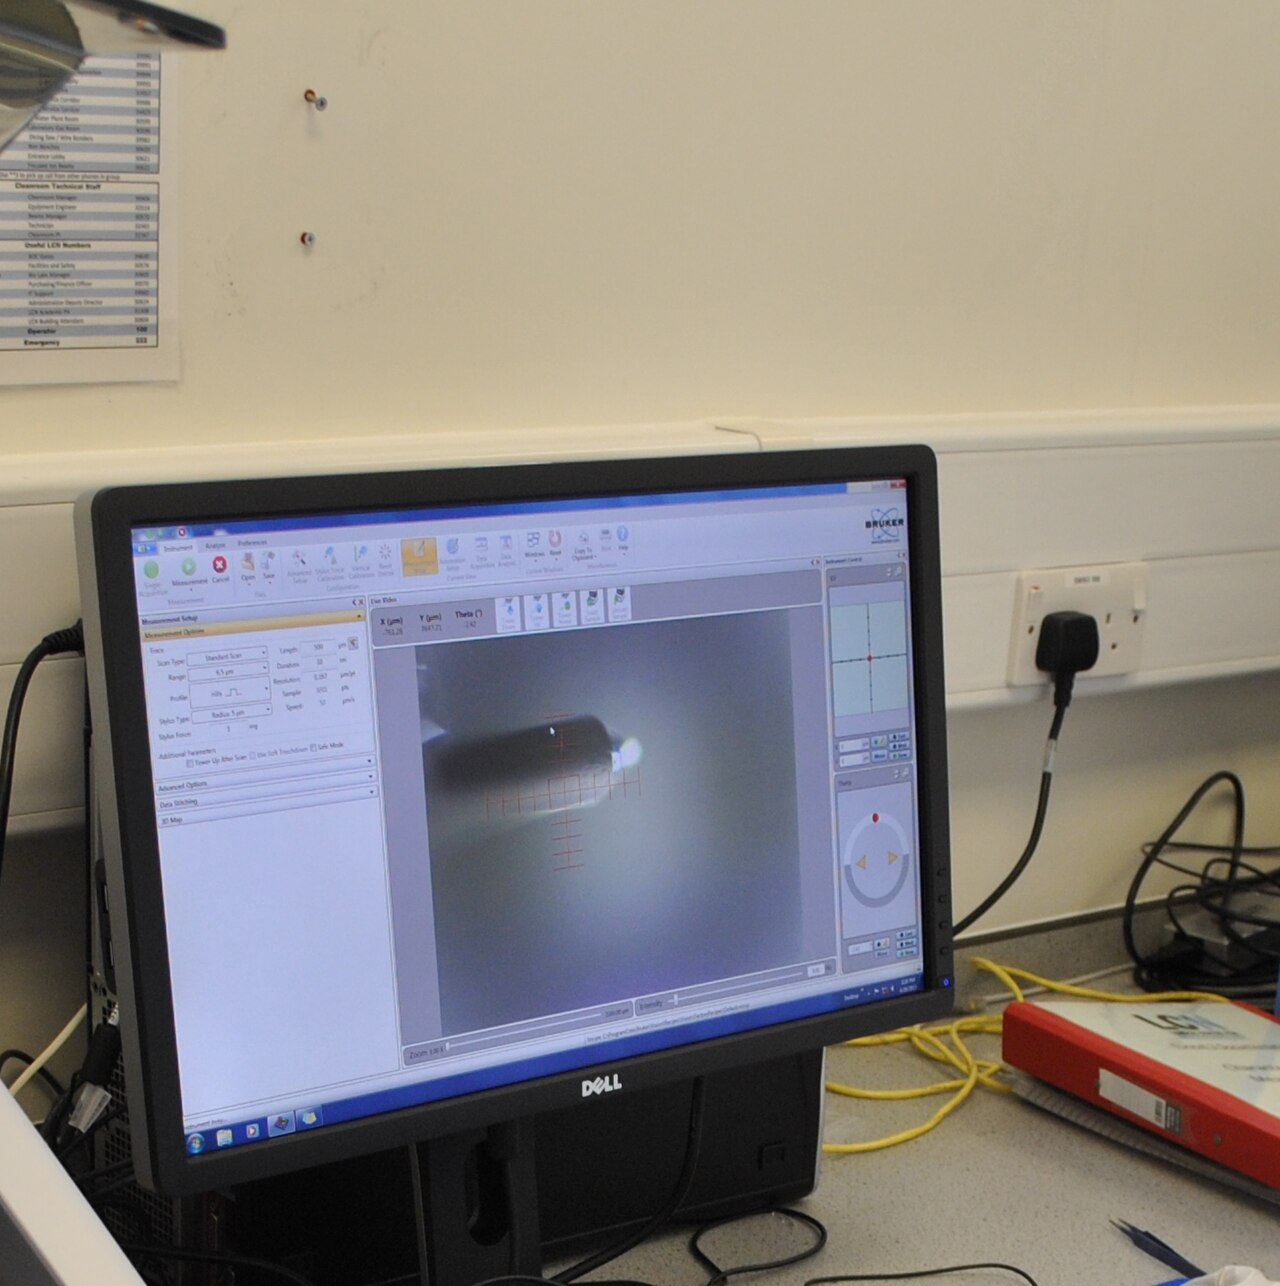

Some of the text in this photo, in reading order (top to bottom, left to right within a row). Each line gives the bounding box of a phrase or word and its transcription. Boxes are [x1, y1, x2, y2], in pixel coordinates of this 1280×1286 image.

[24, 339, 60, 347] Emergency
[865, 519, 904, 529] BRUKER
[238, 538, 268, 547] Preferences
[172, 577, 208, 586] Measurement
[141, 614, 198, 626] Measurement Setup
[144, 627, 205, 639] Measurement Options
[205, 653, 228, 662] Standard
[187, 748, 217, 757] Parameters
[158, 779, 208, 792] Advanced Options
[159, 798, 198, 808] Data Stitching
[170, 816, 183, 824] Map
[409, 1049, 428, 1061] Zoom
[581, 1073, 623, 1098] DELL
